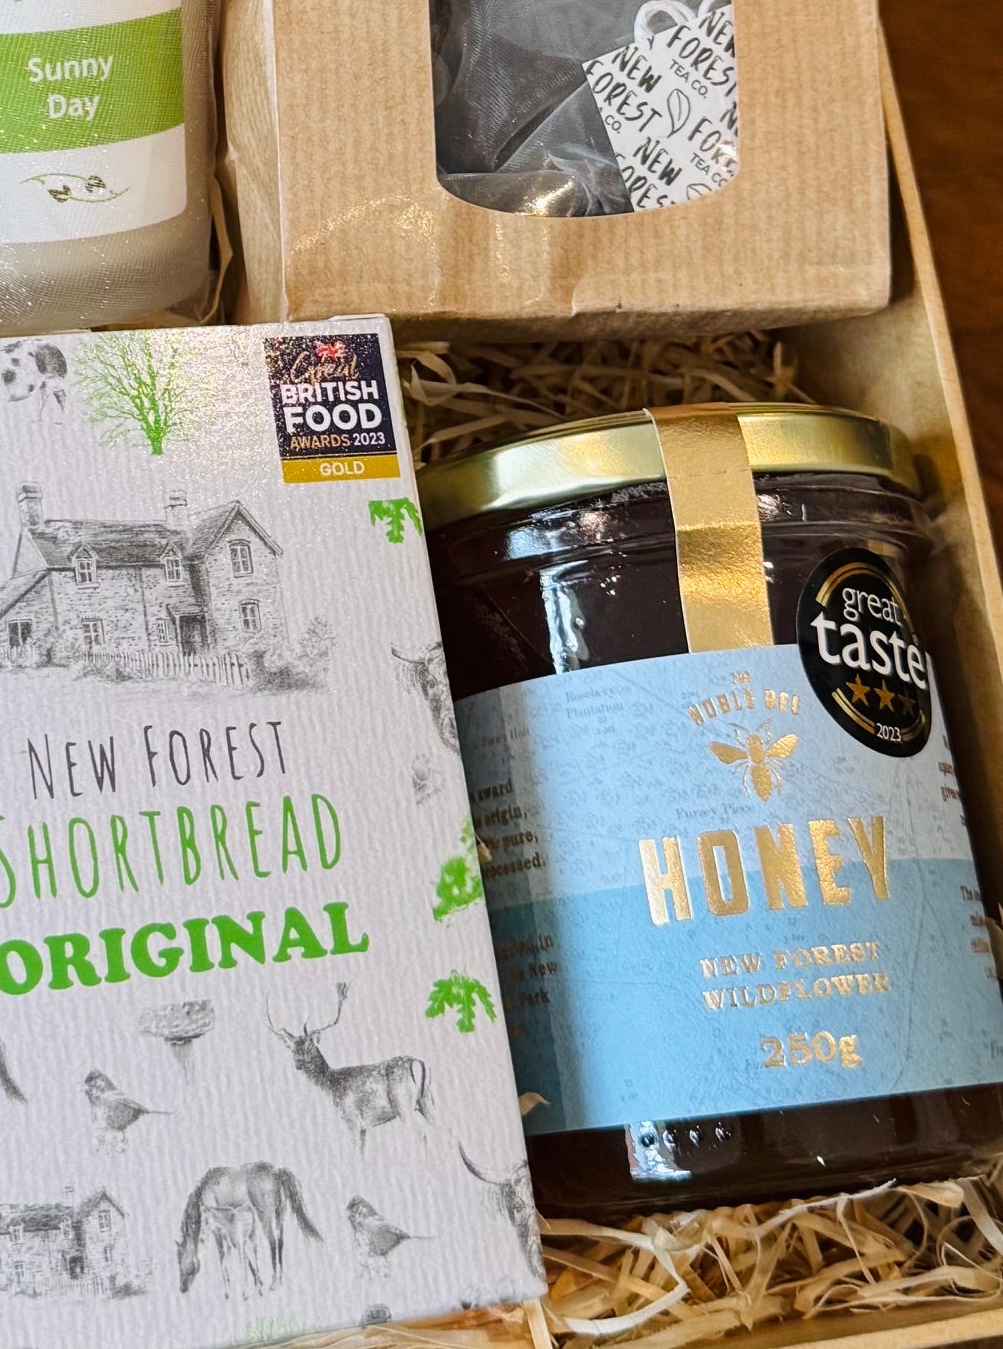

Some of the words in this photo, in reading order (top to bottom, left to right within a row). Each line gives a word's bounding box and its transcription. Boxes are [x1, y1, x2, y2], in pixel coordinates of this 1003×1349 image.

[27, 54, 114, 84] Sunny
[611, 45, 662, 93] NEW
[669, 59, 690, 83] TEA
[690, 79, 710, 99] CO.
[48, 93, 100, 122] Day
[585, 60, 663, 133] FOREST
[633, 136, 683, 187] NEW
[690, 152, 710, 174] TEA
[280, 379, 379, 404] BRITISH
[283, 402, 383, 434] FOOD
[290, 434, 351, 450] AWARDS
[353, 432, 385, 446] 2023
[320, 461, 365, 477] GOLD
[842, 587, 904, 626] great
[810, 611, 928, 690] taste
[688, 688, 755, 725] NOBLE
[876, 723, 902, 742] 2023
[26, 733, 116, 800] NEW
[142, 721, 287, 789] FOREST
[638, 815, 890, 927] HONEY
[700, 952, 762, 979] NEW
[773, 941, 881, 970] FOREST
[702, 972, 892, 1011] WILDFLOWER
[760, 1030, 863, 1068] 250g
